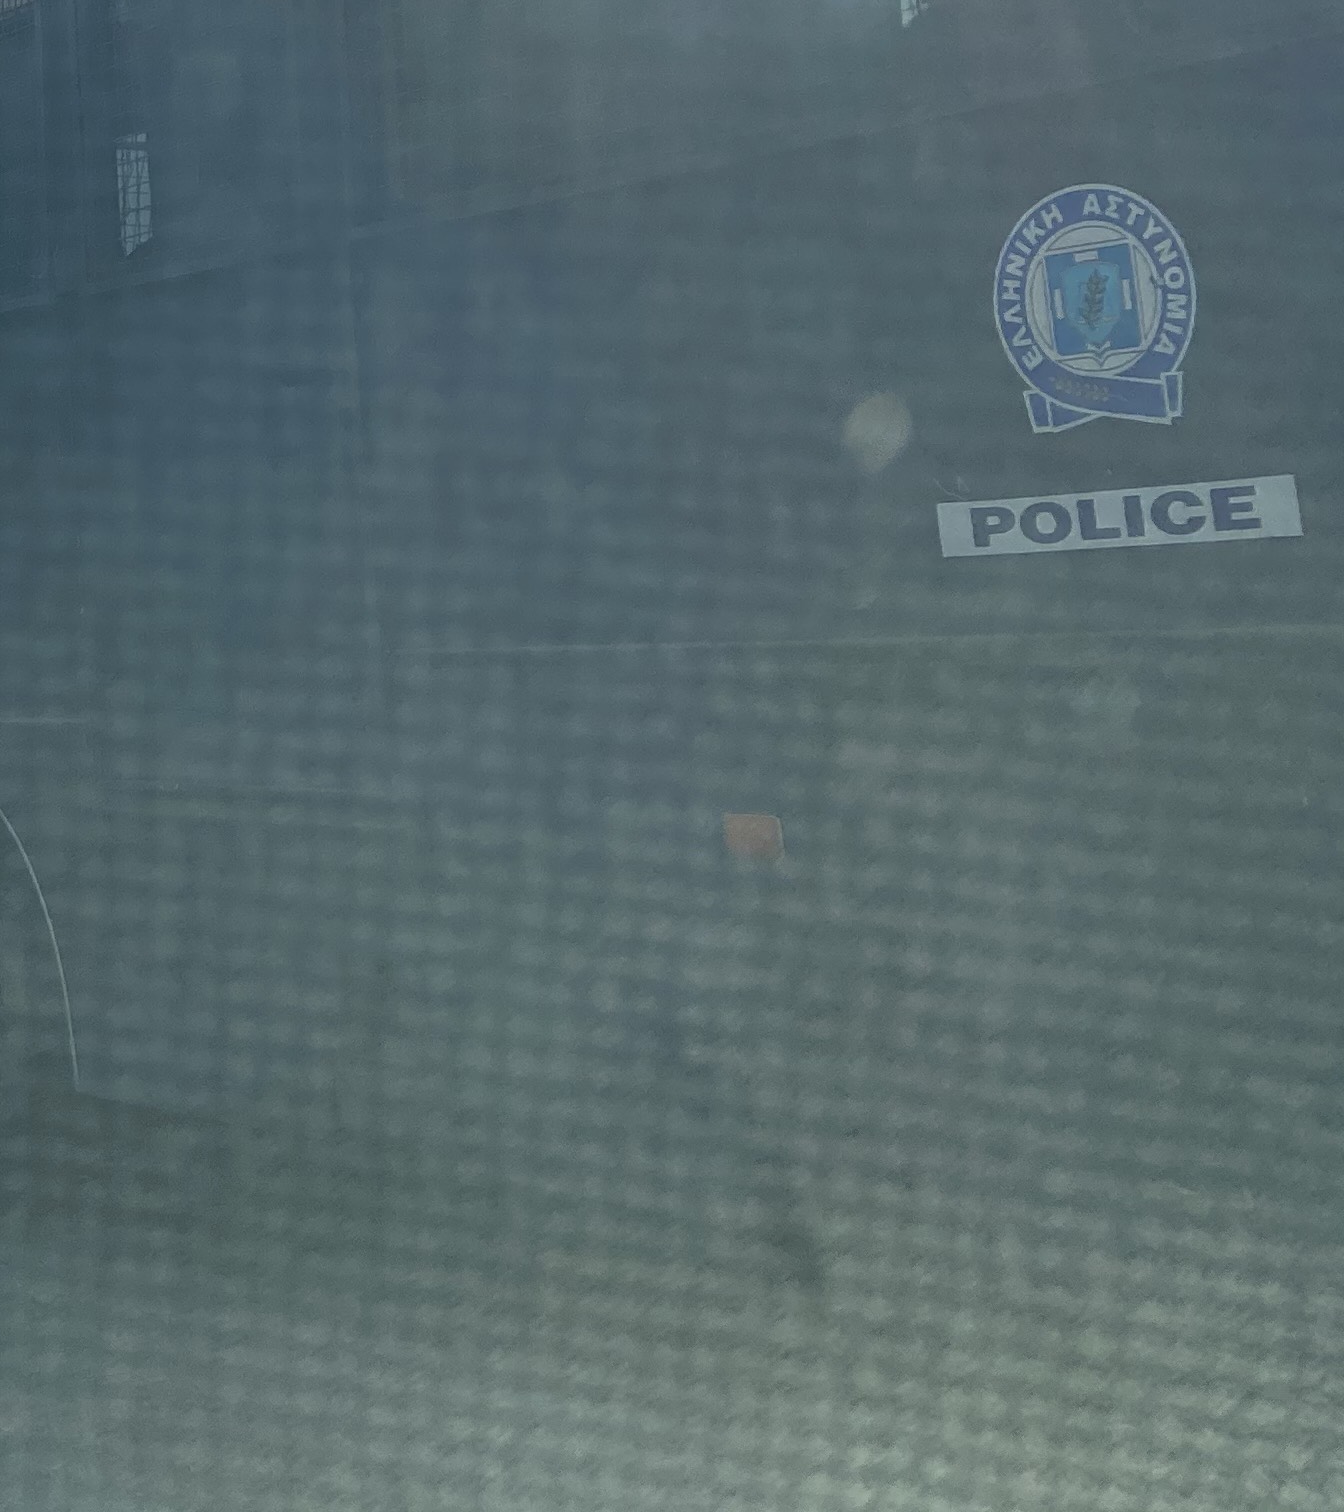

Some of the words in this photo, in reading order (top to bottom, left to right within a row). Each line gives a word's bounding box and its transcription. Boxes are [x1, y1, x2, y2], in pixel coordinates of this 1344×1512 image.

[1001, 203, 1064, 370] ΕΛΛΗΝΙΚΗ
[1082, 193, 1189, 356] ΑΣΤΥΝΟΜΙΑ
[970, 485, 1263, 548] POLICE
